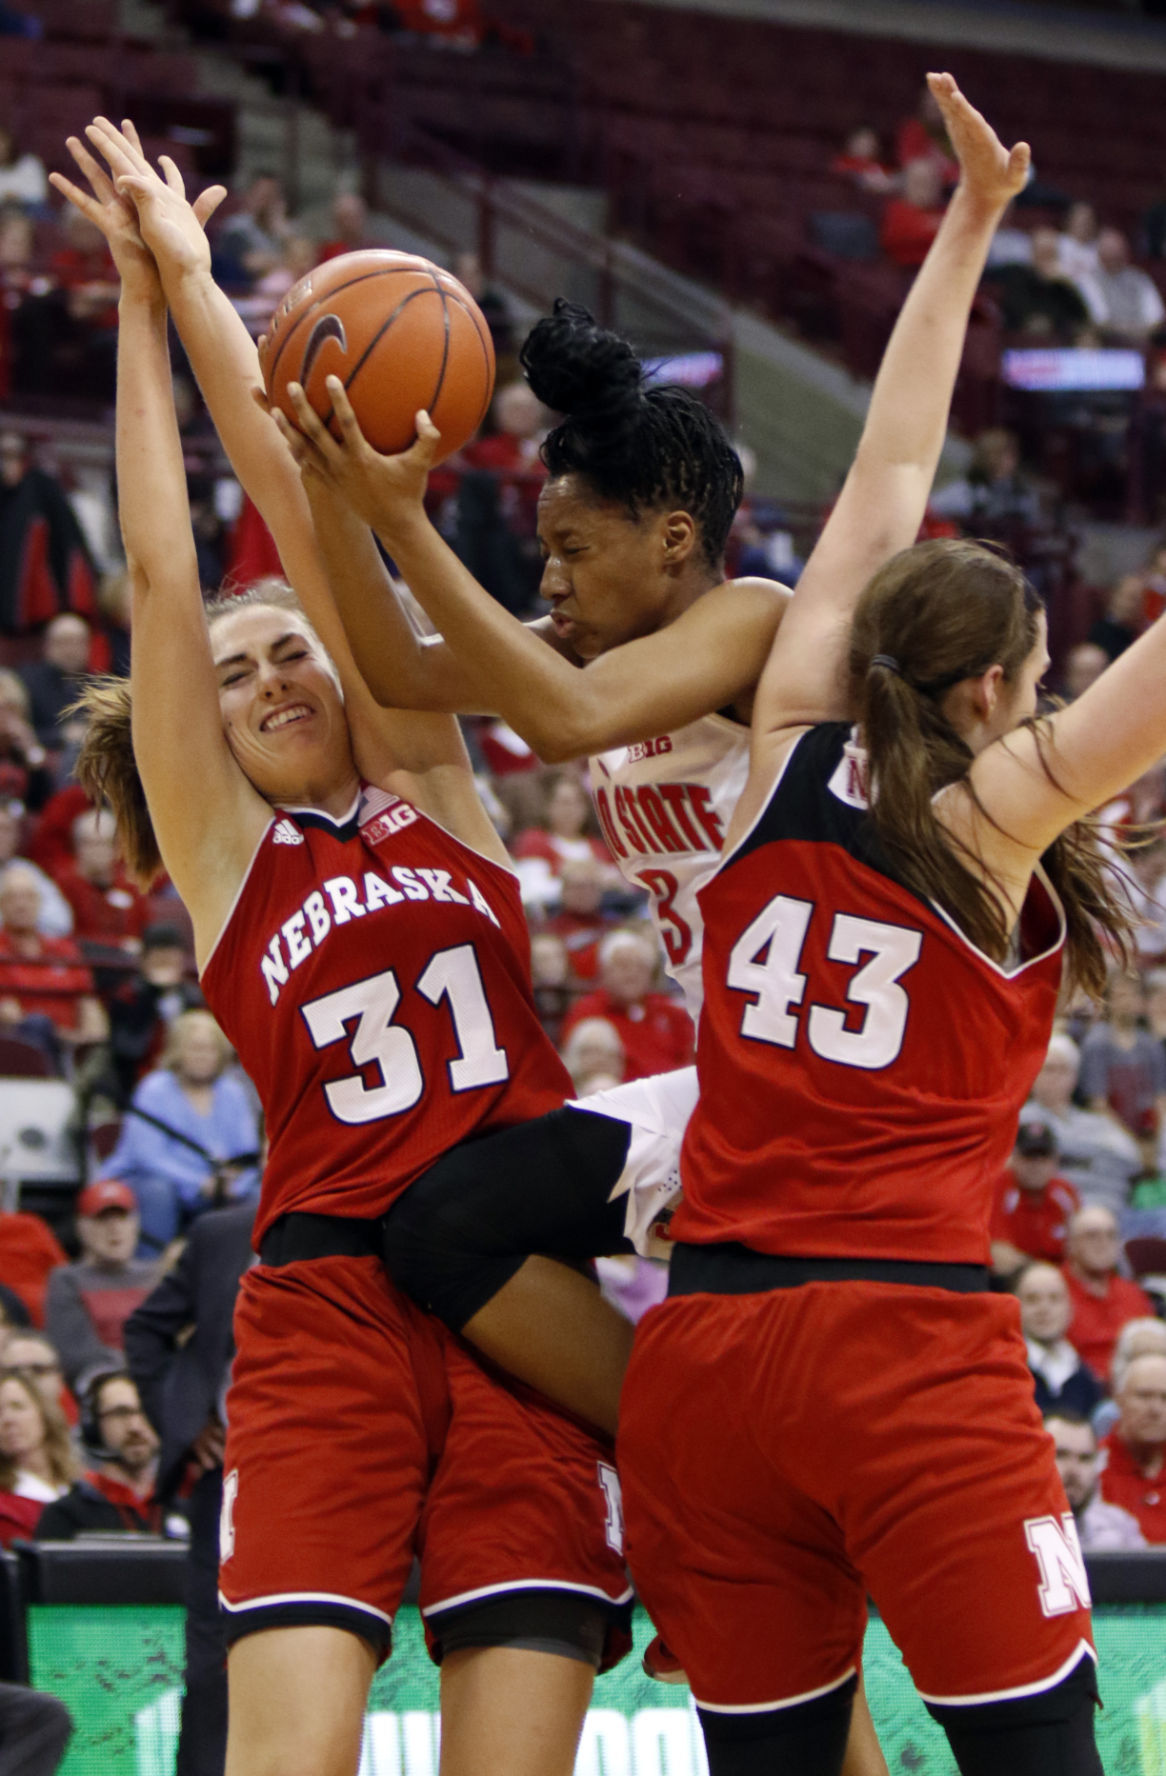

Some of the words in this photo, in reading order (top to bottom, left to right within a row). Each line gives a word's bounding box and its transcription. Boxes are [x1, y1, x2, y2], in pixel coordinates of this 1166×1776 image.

[614, 782, 726, 854] STATE
[260, 865, 501, 1008] NEBRASKA
[726, 893, 924, 1072] 43
[299, 940, 509, 1126] 31
